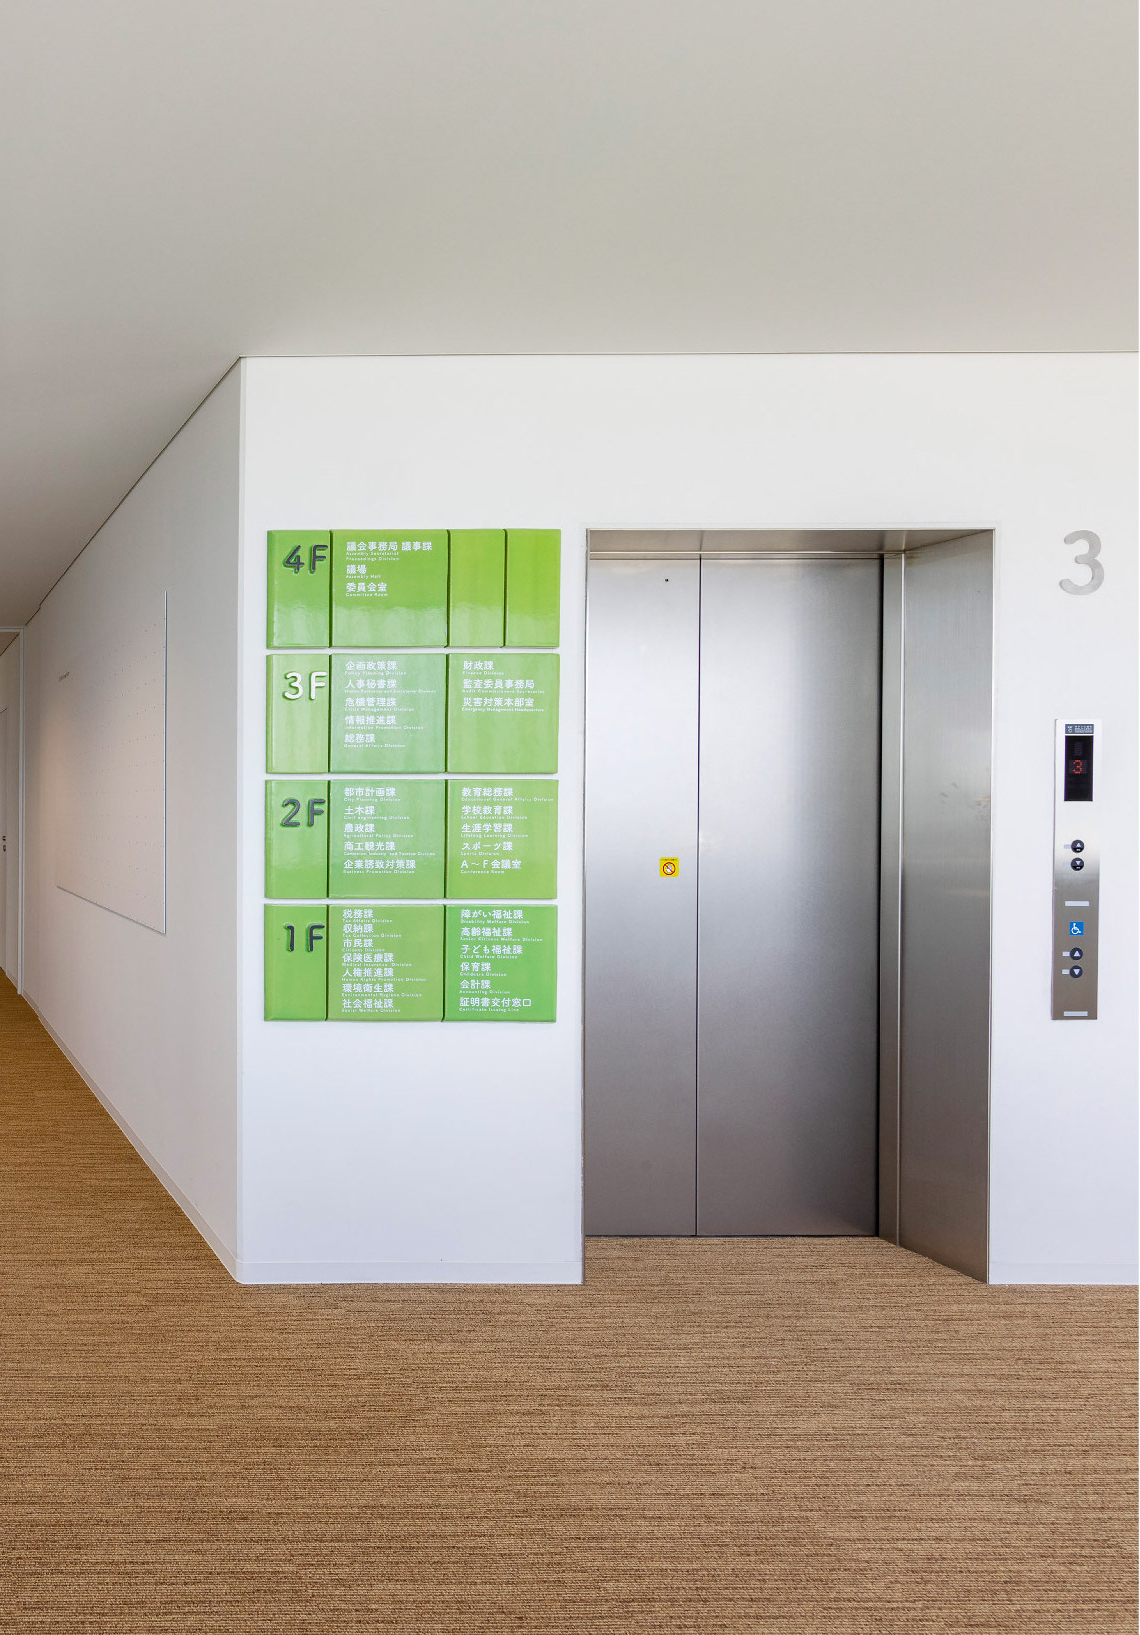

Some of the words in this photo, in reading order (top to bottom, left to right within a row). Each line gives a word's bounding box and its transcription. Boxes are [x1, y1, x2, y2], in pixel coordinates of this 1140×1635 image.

[346, 541, 398, 551] 議会事務局
[401, 541, 432, 551] 議事課
[282, 545, 328, 574] 4F
[1059, 530, 1104, 595] 3
[346, 564, 366, 574] 議場
[346, 582, 387, 592] 委員会室
[346, 661, 397, 671] 企画政策課
[463, 660, 494, 670] 財政課
[284, 671, 327, 700] 3F
[345, 679, 397, 689] 人事秘書課
[463, 679, 535, 689] 監査委員事務局
[345, 697, 396, 707] 危機管理課
[463, 697, 534, 707] 災害対策本部室
[345, 715, 396, 725] 情報推進課
[344, 733, 375, 743] 総務課
[1072, 759, 1083, 774] 3
[345, 787, 396, 797] 都市計画課
[462, 787, 513, 797] 教育総務課
[281, 798, 326, 827] 2F
[344, 805, 375, 815] 土木課
[462, 805, 513, 815] 学校教育課
[344, 823, 375, 833] 農政課
[461, 823, 513, 833] 生涯学習課
[344, 841, 395, 851] 商工観光課
[462, 842, 513, 851] スポーツ課
[344, 859, 416, 869] 企業誘致対策課
[343, 909, 373, 918] 税務課
[461, 909, 523, 919] 障がい福祉課
[343, 923, 373, 933] 収納課
[461, 927, 512, 937] 高齢福祉課
[284, 924, 325, 952] 1F
[343, 938, 373, 948] 市民課
[461, 944, 523, 955] 子ども福祉課
[342, 953, 394, 962] 保険医療課
[460, 962, 491, 972] 保育課
[343, 968, 394, 977] 人権推進課
[342, 983, 394, 992] 環境衛生課
[460, 979, 491, 989] 会計課
[342, 998, 394, 1008] 社会福祉課
[460, 997, 532, 1007] 証明書交付窓口
